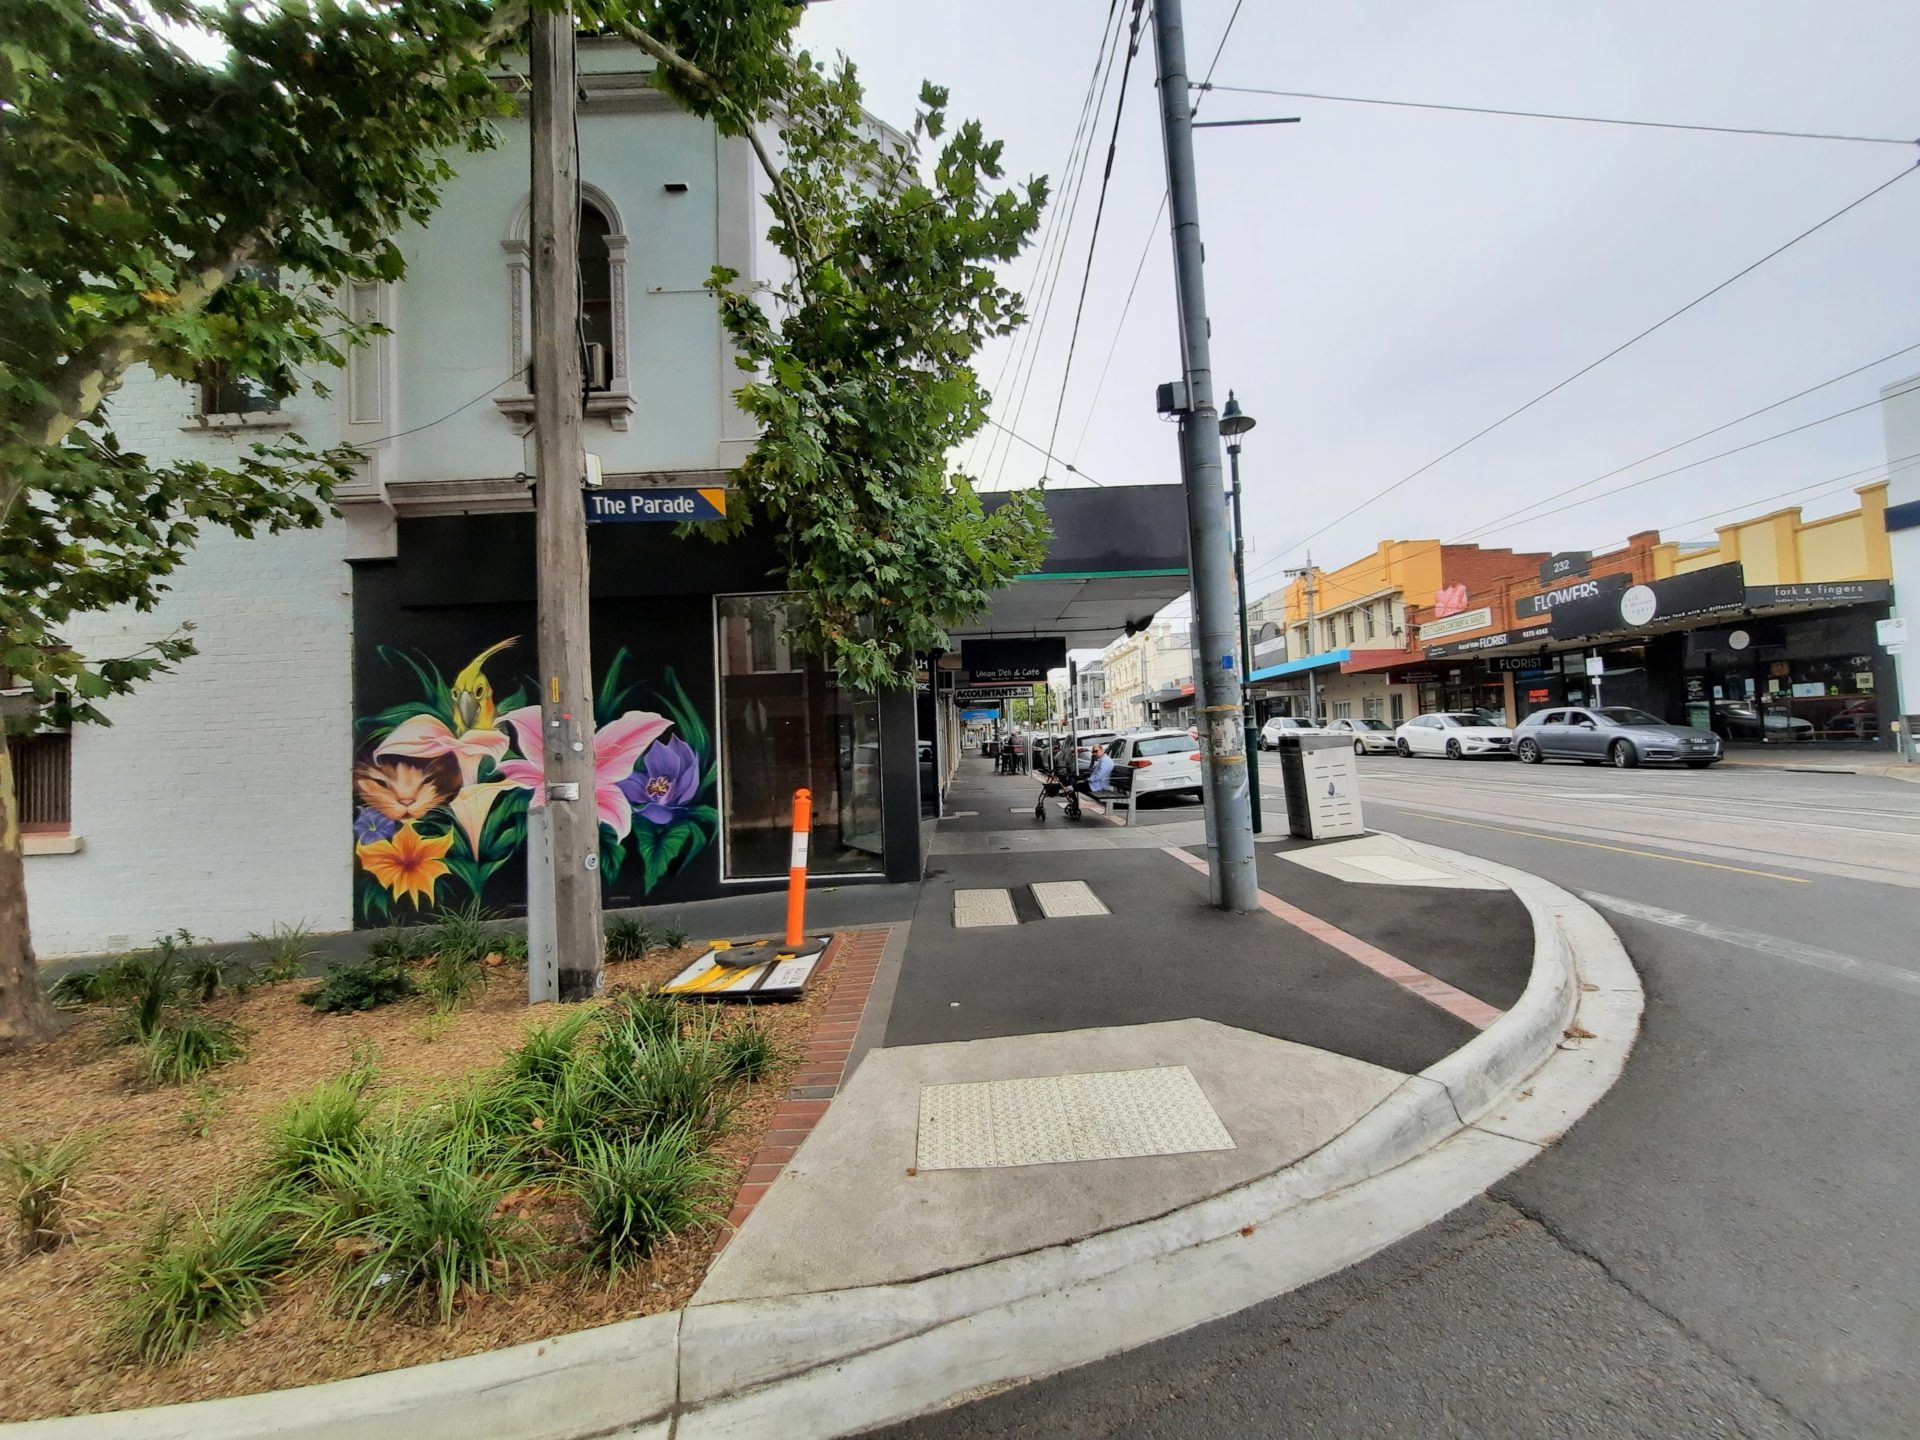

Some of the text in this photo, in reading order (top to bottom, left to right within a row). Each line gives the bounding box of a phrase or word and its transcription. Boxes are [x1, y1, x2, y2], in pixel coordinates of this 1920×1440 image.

[592, 495, 695, 514] The Parade
[1553, 560, 1570, 573] 232
[1775, 584, 1864, 596] fork & fingers
[1534, 581, 1599, 612] FLOWERS
[1708, 602, 1742, 611] difference
[1480, 633, 1508, 648] FLORIST
[1500, 657, 1541, 669] FLORIST
[976, 669, 996, 678] Union
[998, 668, 1012, 677] Deli
[1013, 668, 1020, 676] &
[956, 688, 1018, 699] ACCOUNTANTS
